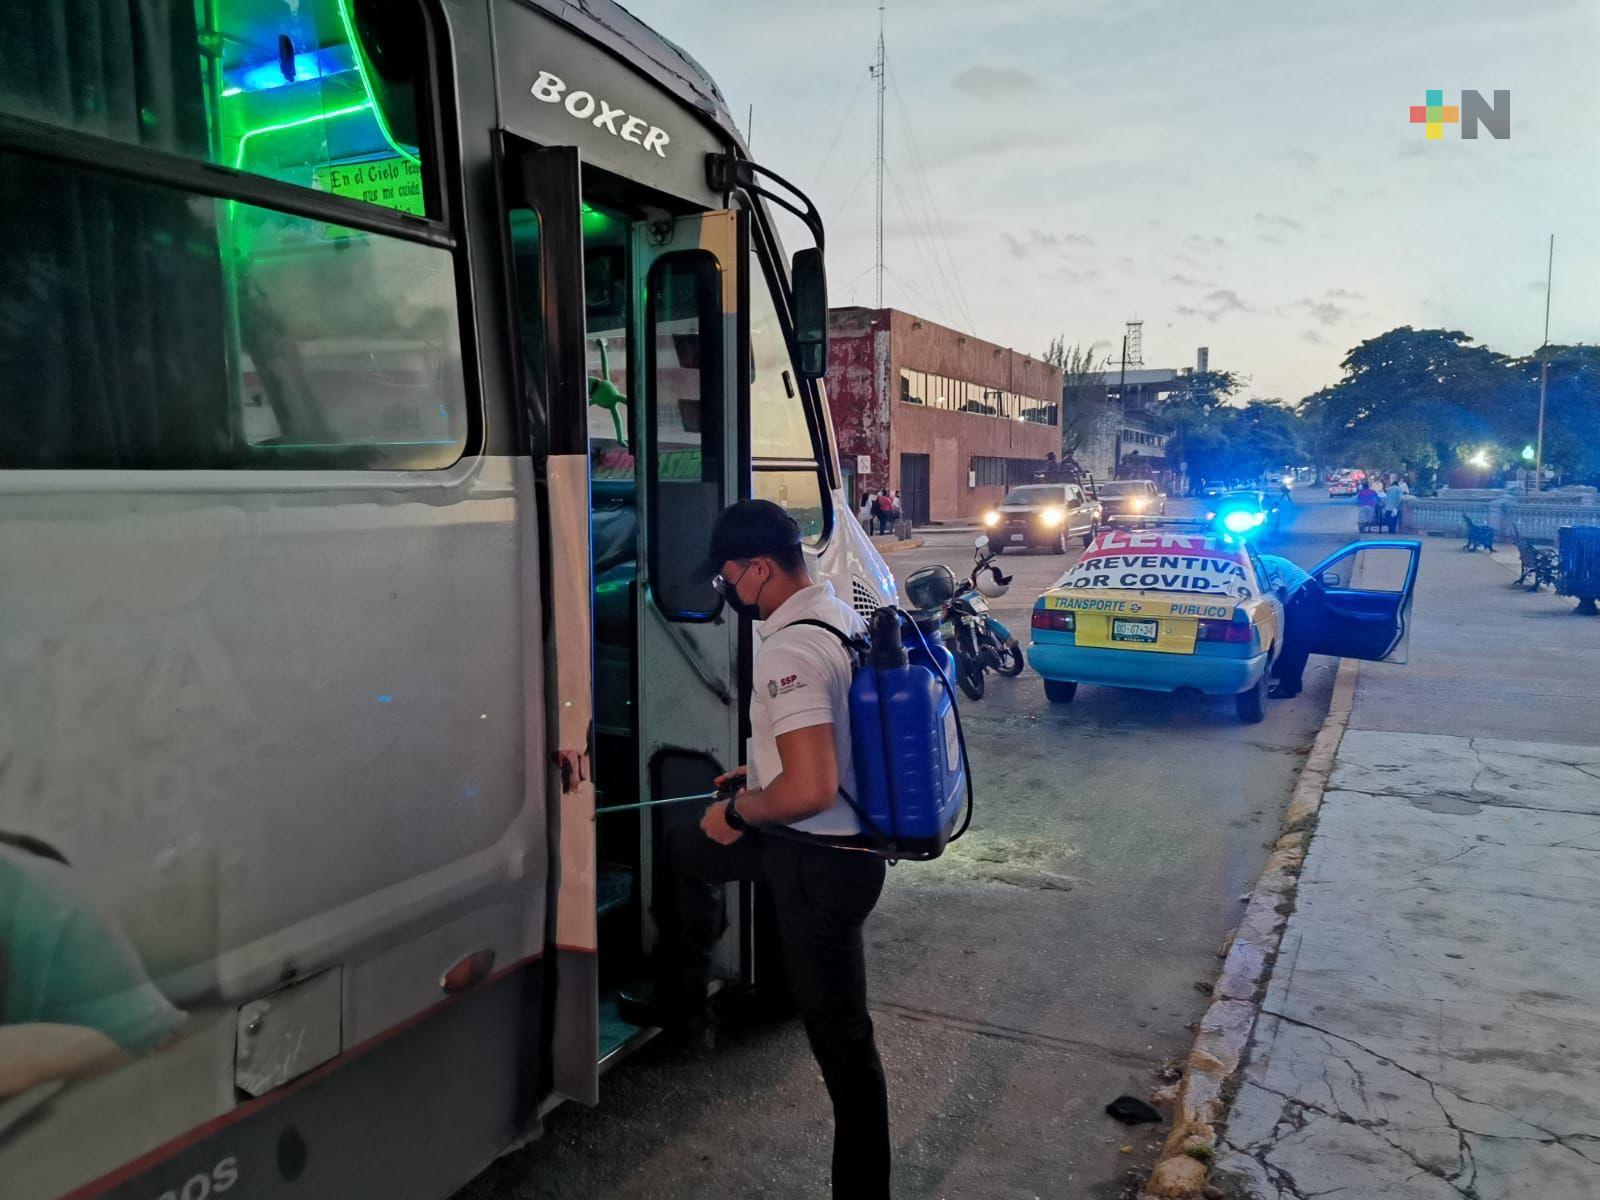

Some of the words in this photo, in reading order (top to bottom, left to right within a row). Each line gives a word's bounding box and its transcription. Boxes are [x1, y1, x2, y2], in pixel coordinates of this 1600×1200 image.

[531, 71, 670, 158] BOXER
[331, 171, 350, 188] En
[354, 169, 364, 185] el
[368, 163, 399, 182] Cielo
[382, 186, 394, 199] me
[1069, 556, 1247, 580] PREVENTIVA
[1054, 598, 1126, 612] TRANSPORTE
[1170, 603, 1228, 618] PUBLICO
[780, 674, 797, 687] SSP
